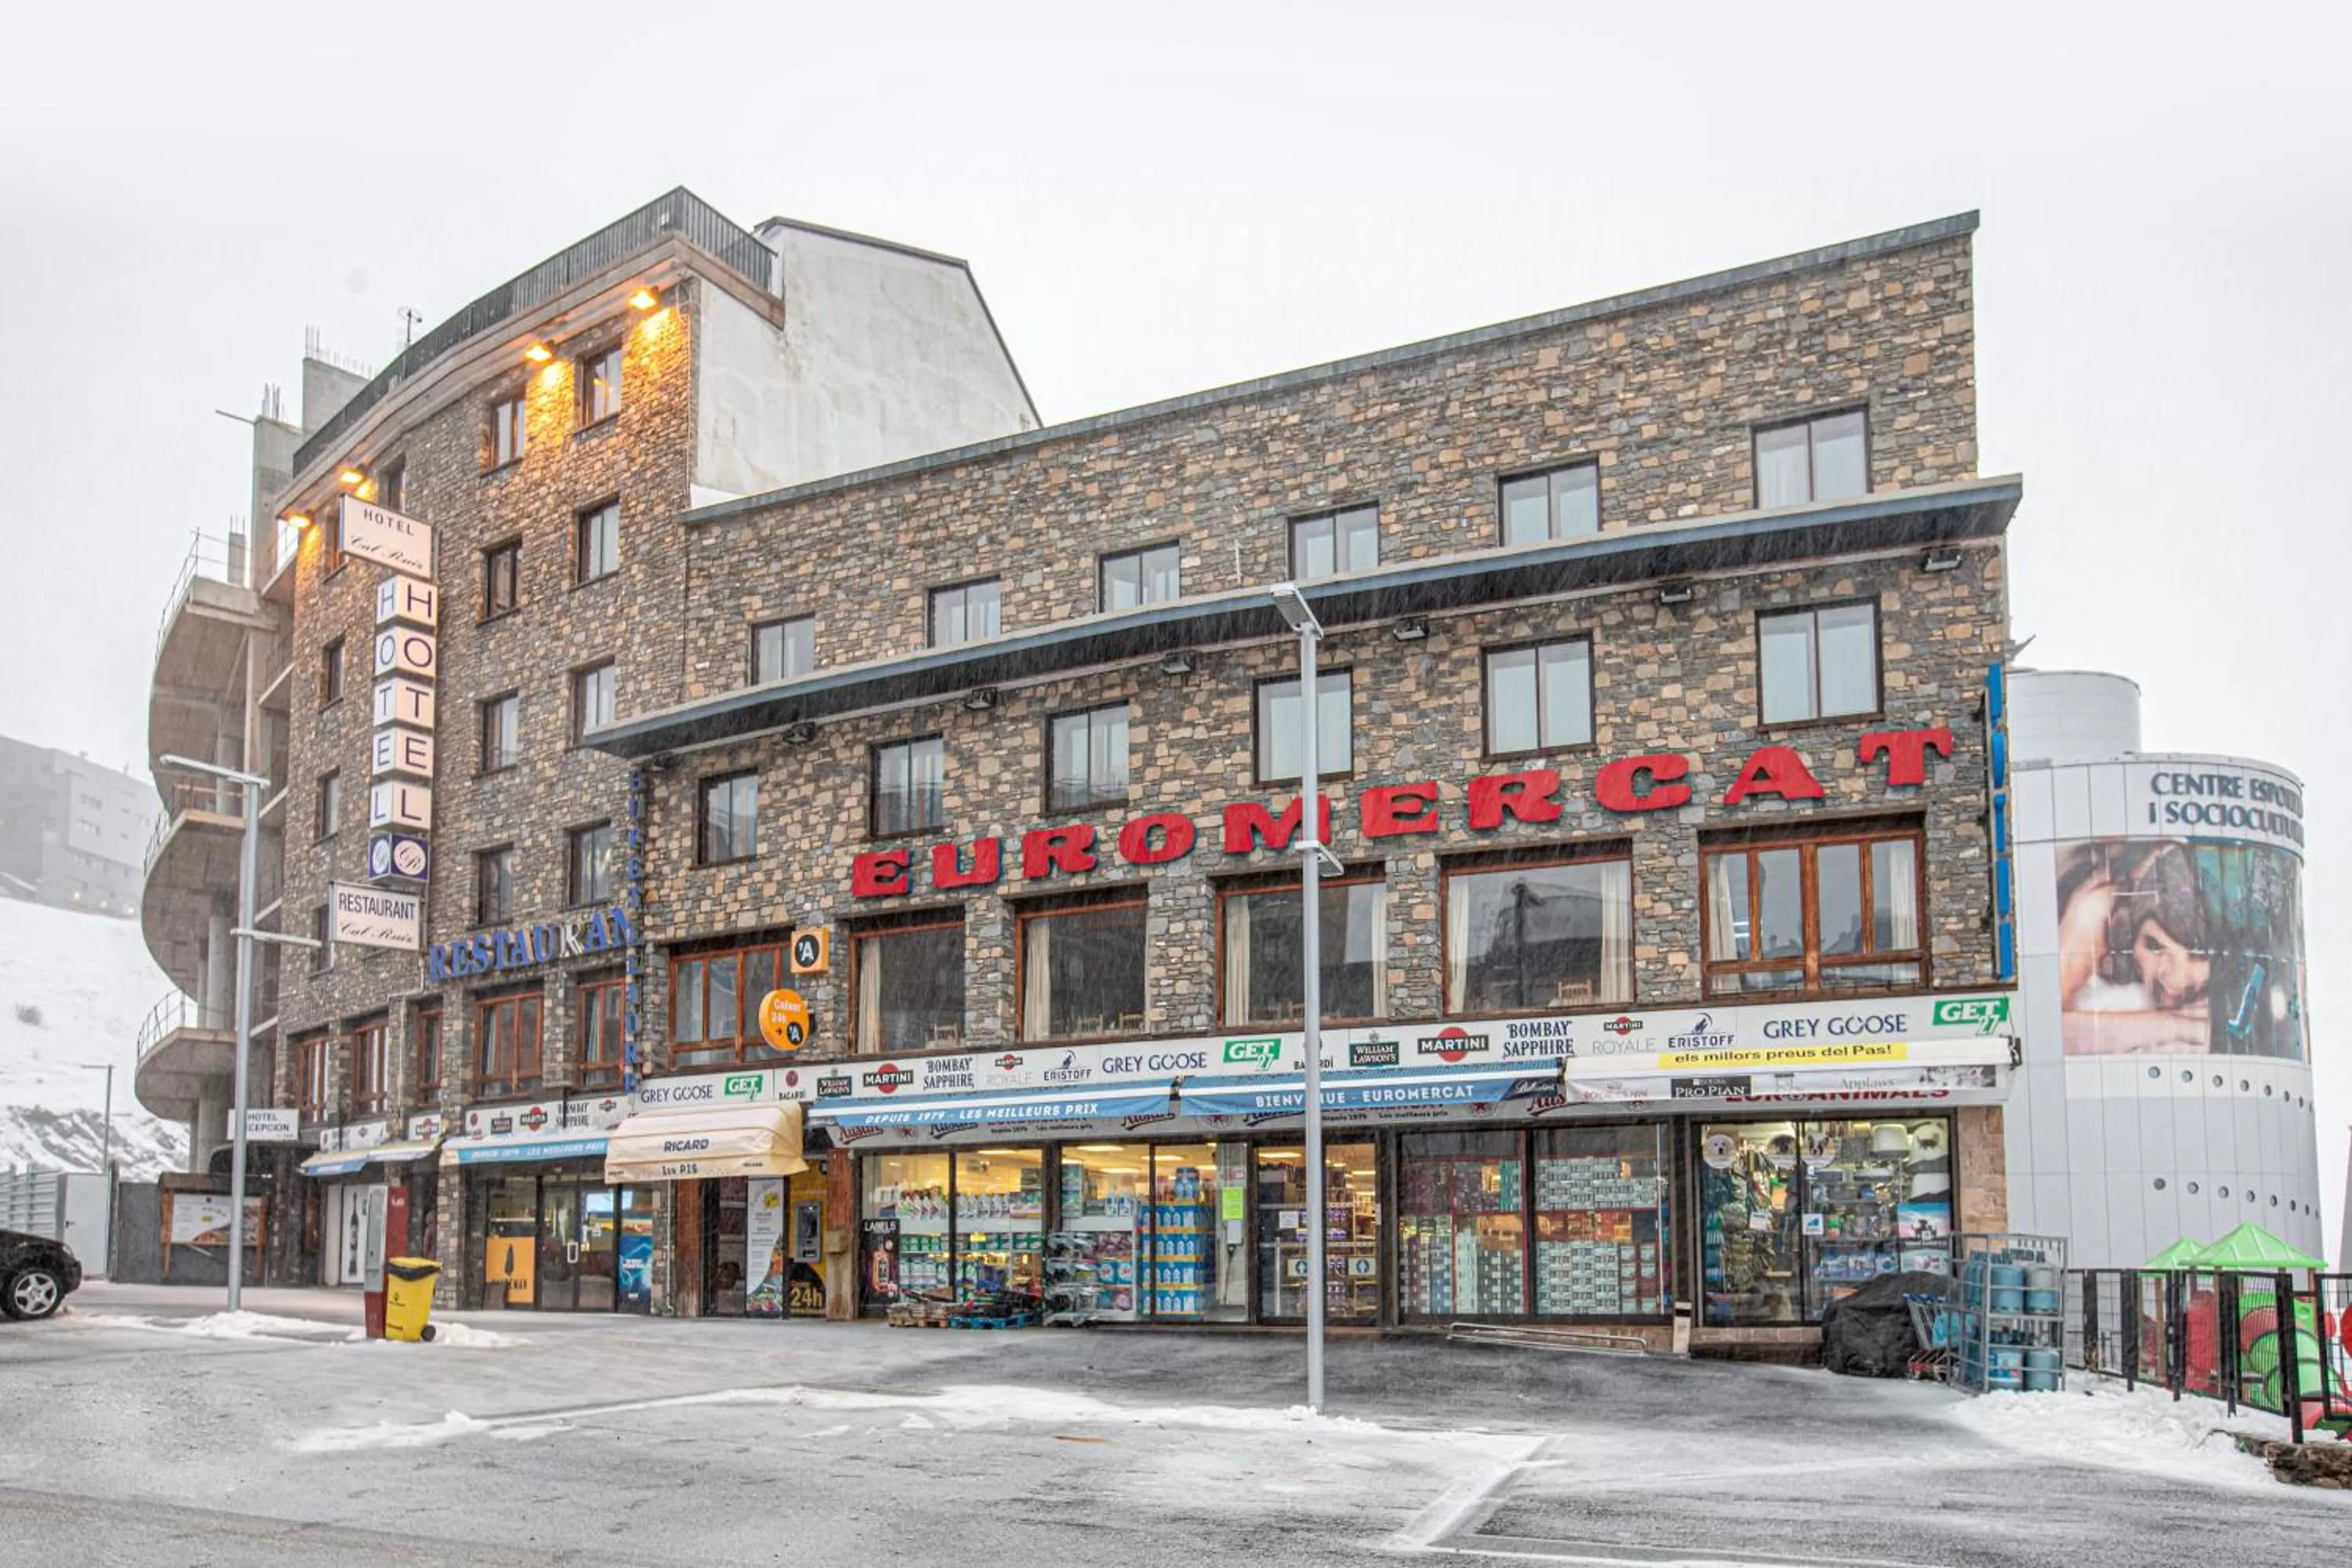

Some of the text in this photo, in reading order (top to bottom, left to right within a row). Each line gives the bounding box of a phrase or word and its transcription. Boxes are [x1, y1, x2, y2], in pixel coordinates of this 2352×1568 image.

[364, 508, 414, 536] HOTEL
[375, 583, 395, 818] HOTEL
[401, 583, 433, 822] HOTEL
[2151, 772, 2243, 798] CENTRE
[852, 727, 1955, 898] EUROMERCAT
[338, 893, 416, 920] RESTAURANT
[1940, 1001, 2000, 1022] GET
[1507, 1021, 1572, 1039] BOMBAY
[1606, 1022, 1642, 1030] MARTINI
[1763, 1014, 1907, 1038] GREY GOOSE
[1229, 1040, 1275, 1059] GET
[1356, 1044, 1394, 1054] WILLIAM
[1421, 1038, 1486, 1052] MARTINI
[1503, 1038, 1575, 1059] SAPPHIRE
[1592, 1037, 1656, 1054] ROYALE
[1668, 1034, 1735, 1048] ERISTOFF
[1102, 1052, 1208, 1074] GREY GOOSE
[1675, 1044, 1892, 1063] els millors preus del Pas!
[926, 1058, 972, 1073] BOMBAY
[1044, 1069, 1092, 1081] ERISTOFF
[728, 1076, 758, 1092] GET
[865, 1073, 912, 1086] MARTINI
[923, 1073, 975, 1091] SAPPHIRE
[1840, 1076, 1896, 1091] Applaws
[641, 1084, 713, 1103] GREY GOOSE
[1256, 1091, 1345, 1108] BIENVUE
[1362, 1084, 1474, 1103] EUROMERCAT
[1675, 1085, 1745, 1098] PRO PLAN
[248, 1112, 278, 1122] HOTEL
[865, 1113, 910, 1124] DEPUIS
[917, 1111, 944, 1122] 1979
[959, 1109, 982, 1120] LES
[987, 1104, 1060, 1118] MEILLEURS
[1065, 1102, 1098, 1115] PRIX
[663, 1138, 710, 1152] RICARD
[790, 1287, 823, 1308] 24h
